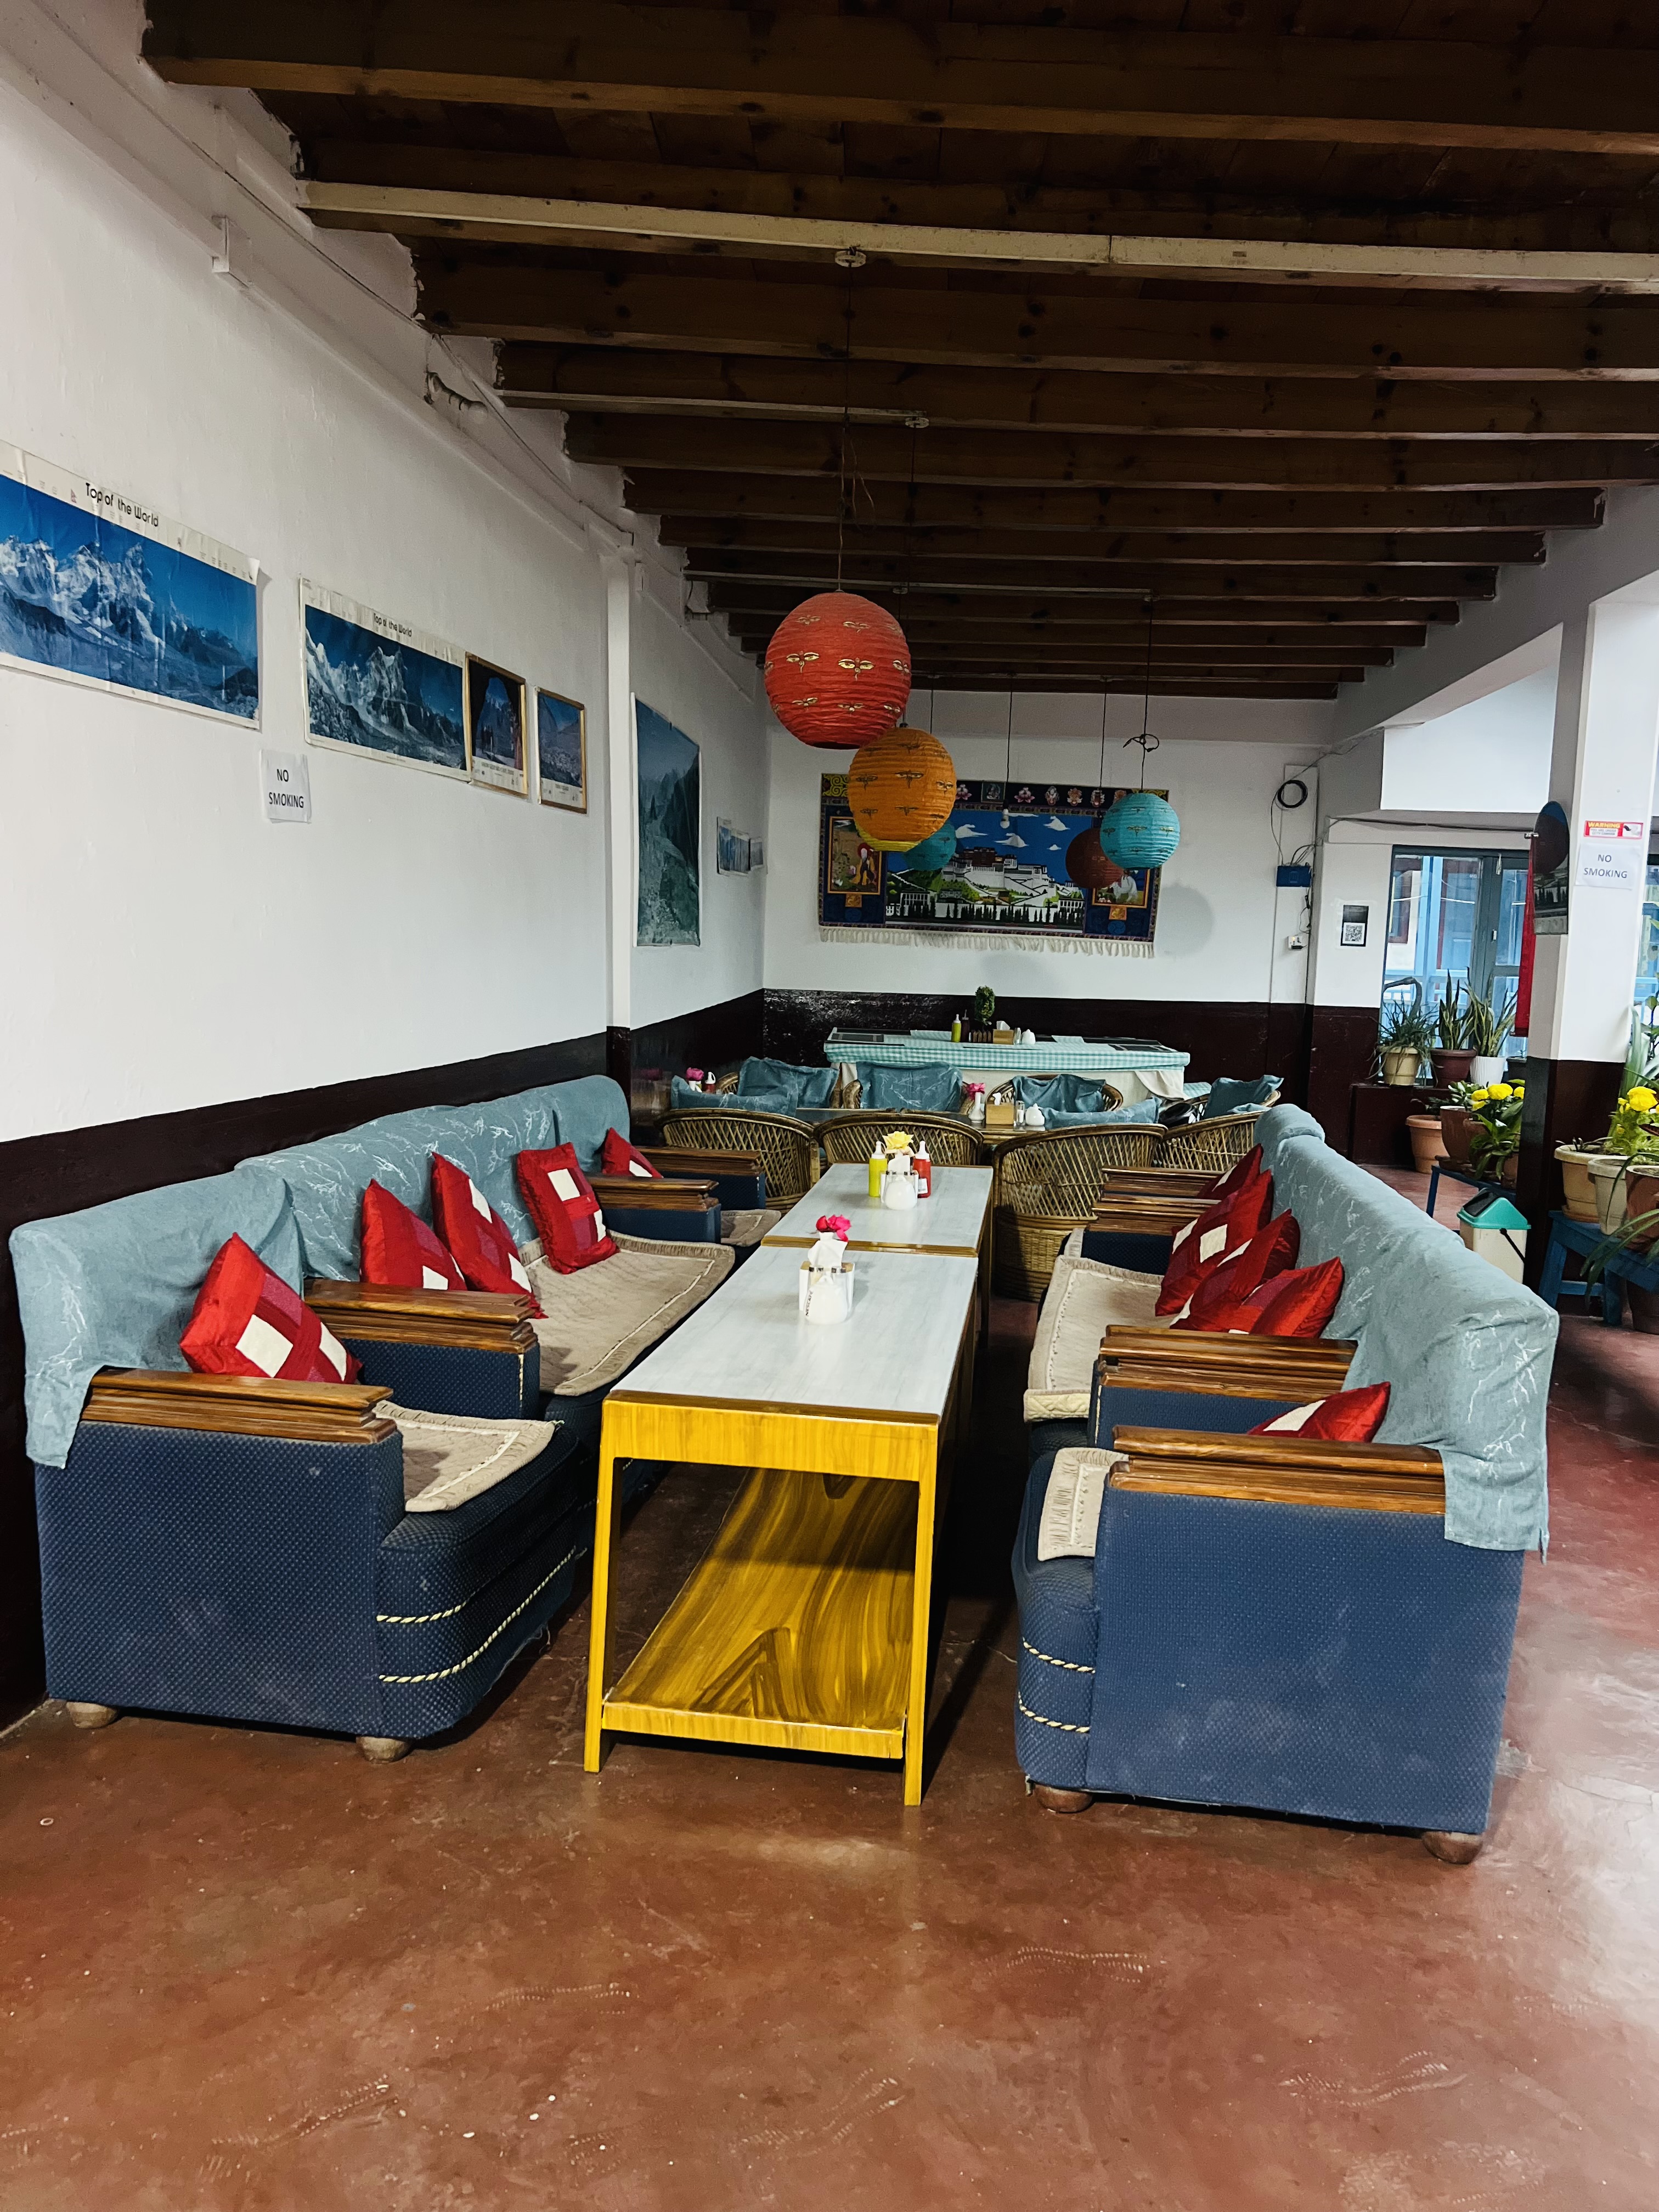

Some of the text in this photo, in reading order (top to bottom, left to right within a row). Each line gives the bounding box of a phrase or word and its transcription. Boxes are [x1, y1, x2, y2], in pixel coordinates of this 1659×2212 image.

[86, 482, 103, 503] Top
[105, 494, 113, 506] of
[118, 498, 132, 515] the
[134, 505, 159, 527] World
[374, 613, 382, 626] Top
[389, 619, 398, 631] the
[398, 623, 412, 637] World
[276, 769, 289, 782] NO
[268, 792, 304, 808] SMOKING
[1598, 854, 1612, 862] NO
[1583, 867, 1628, 878] SMOKING
